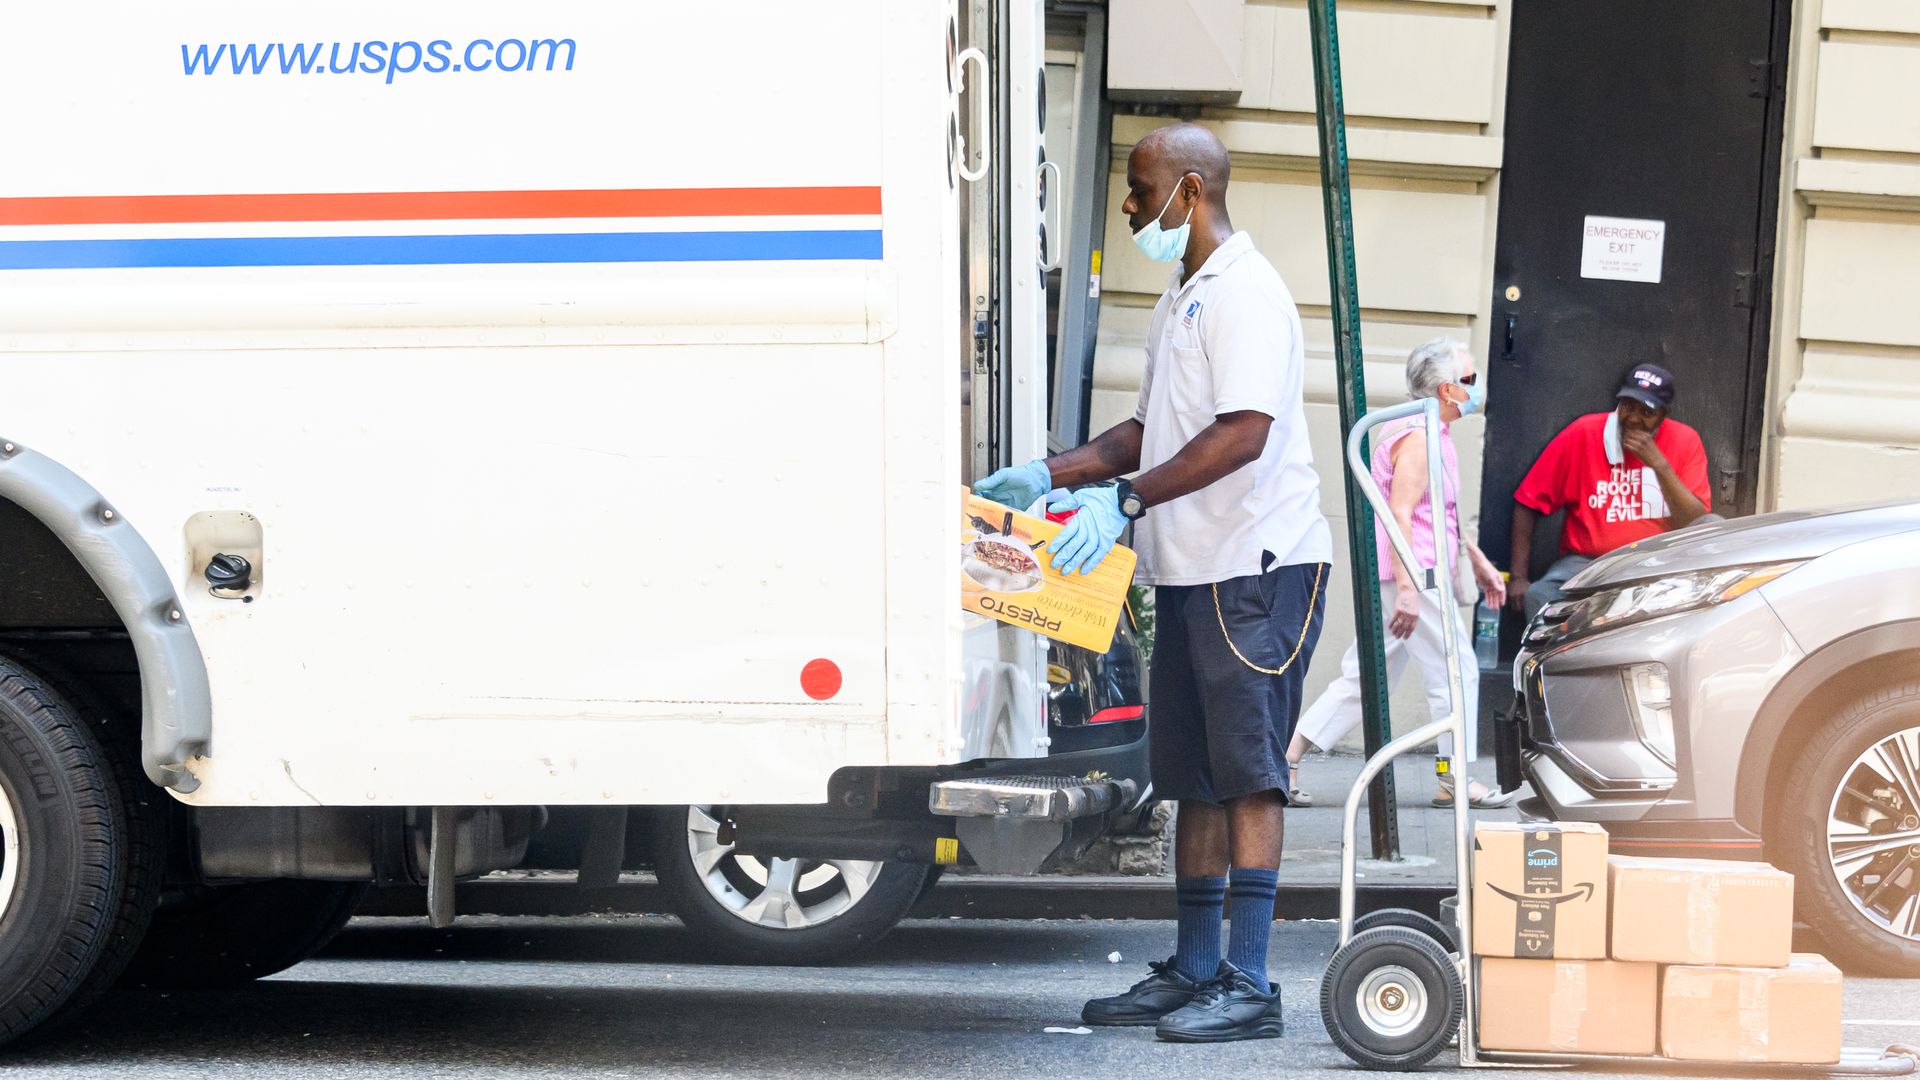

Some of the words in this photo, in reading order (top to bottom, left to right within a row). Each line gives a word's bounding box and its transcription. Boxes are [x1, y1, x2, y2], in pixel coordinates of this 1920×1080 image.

[181, 38, 577, 84] www.usps.com
[1586, 225, 1660, 241] EMERGENCY
[1609, 242, 1636, 254] EXIT
[1610, 468, 1641, 482] THE
[1596, 480, 1640, 496] ROOT
[1588, 494, 1608, 509] OF
[1610, 495, 1641, 509] ALL
[1606, 508, 1642, 523] EVIL
[980, 596, 1062, 632] PRESTO
[1083, 610, 1107, 628] Wok
[1527, 856, 1558, 868] prime
